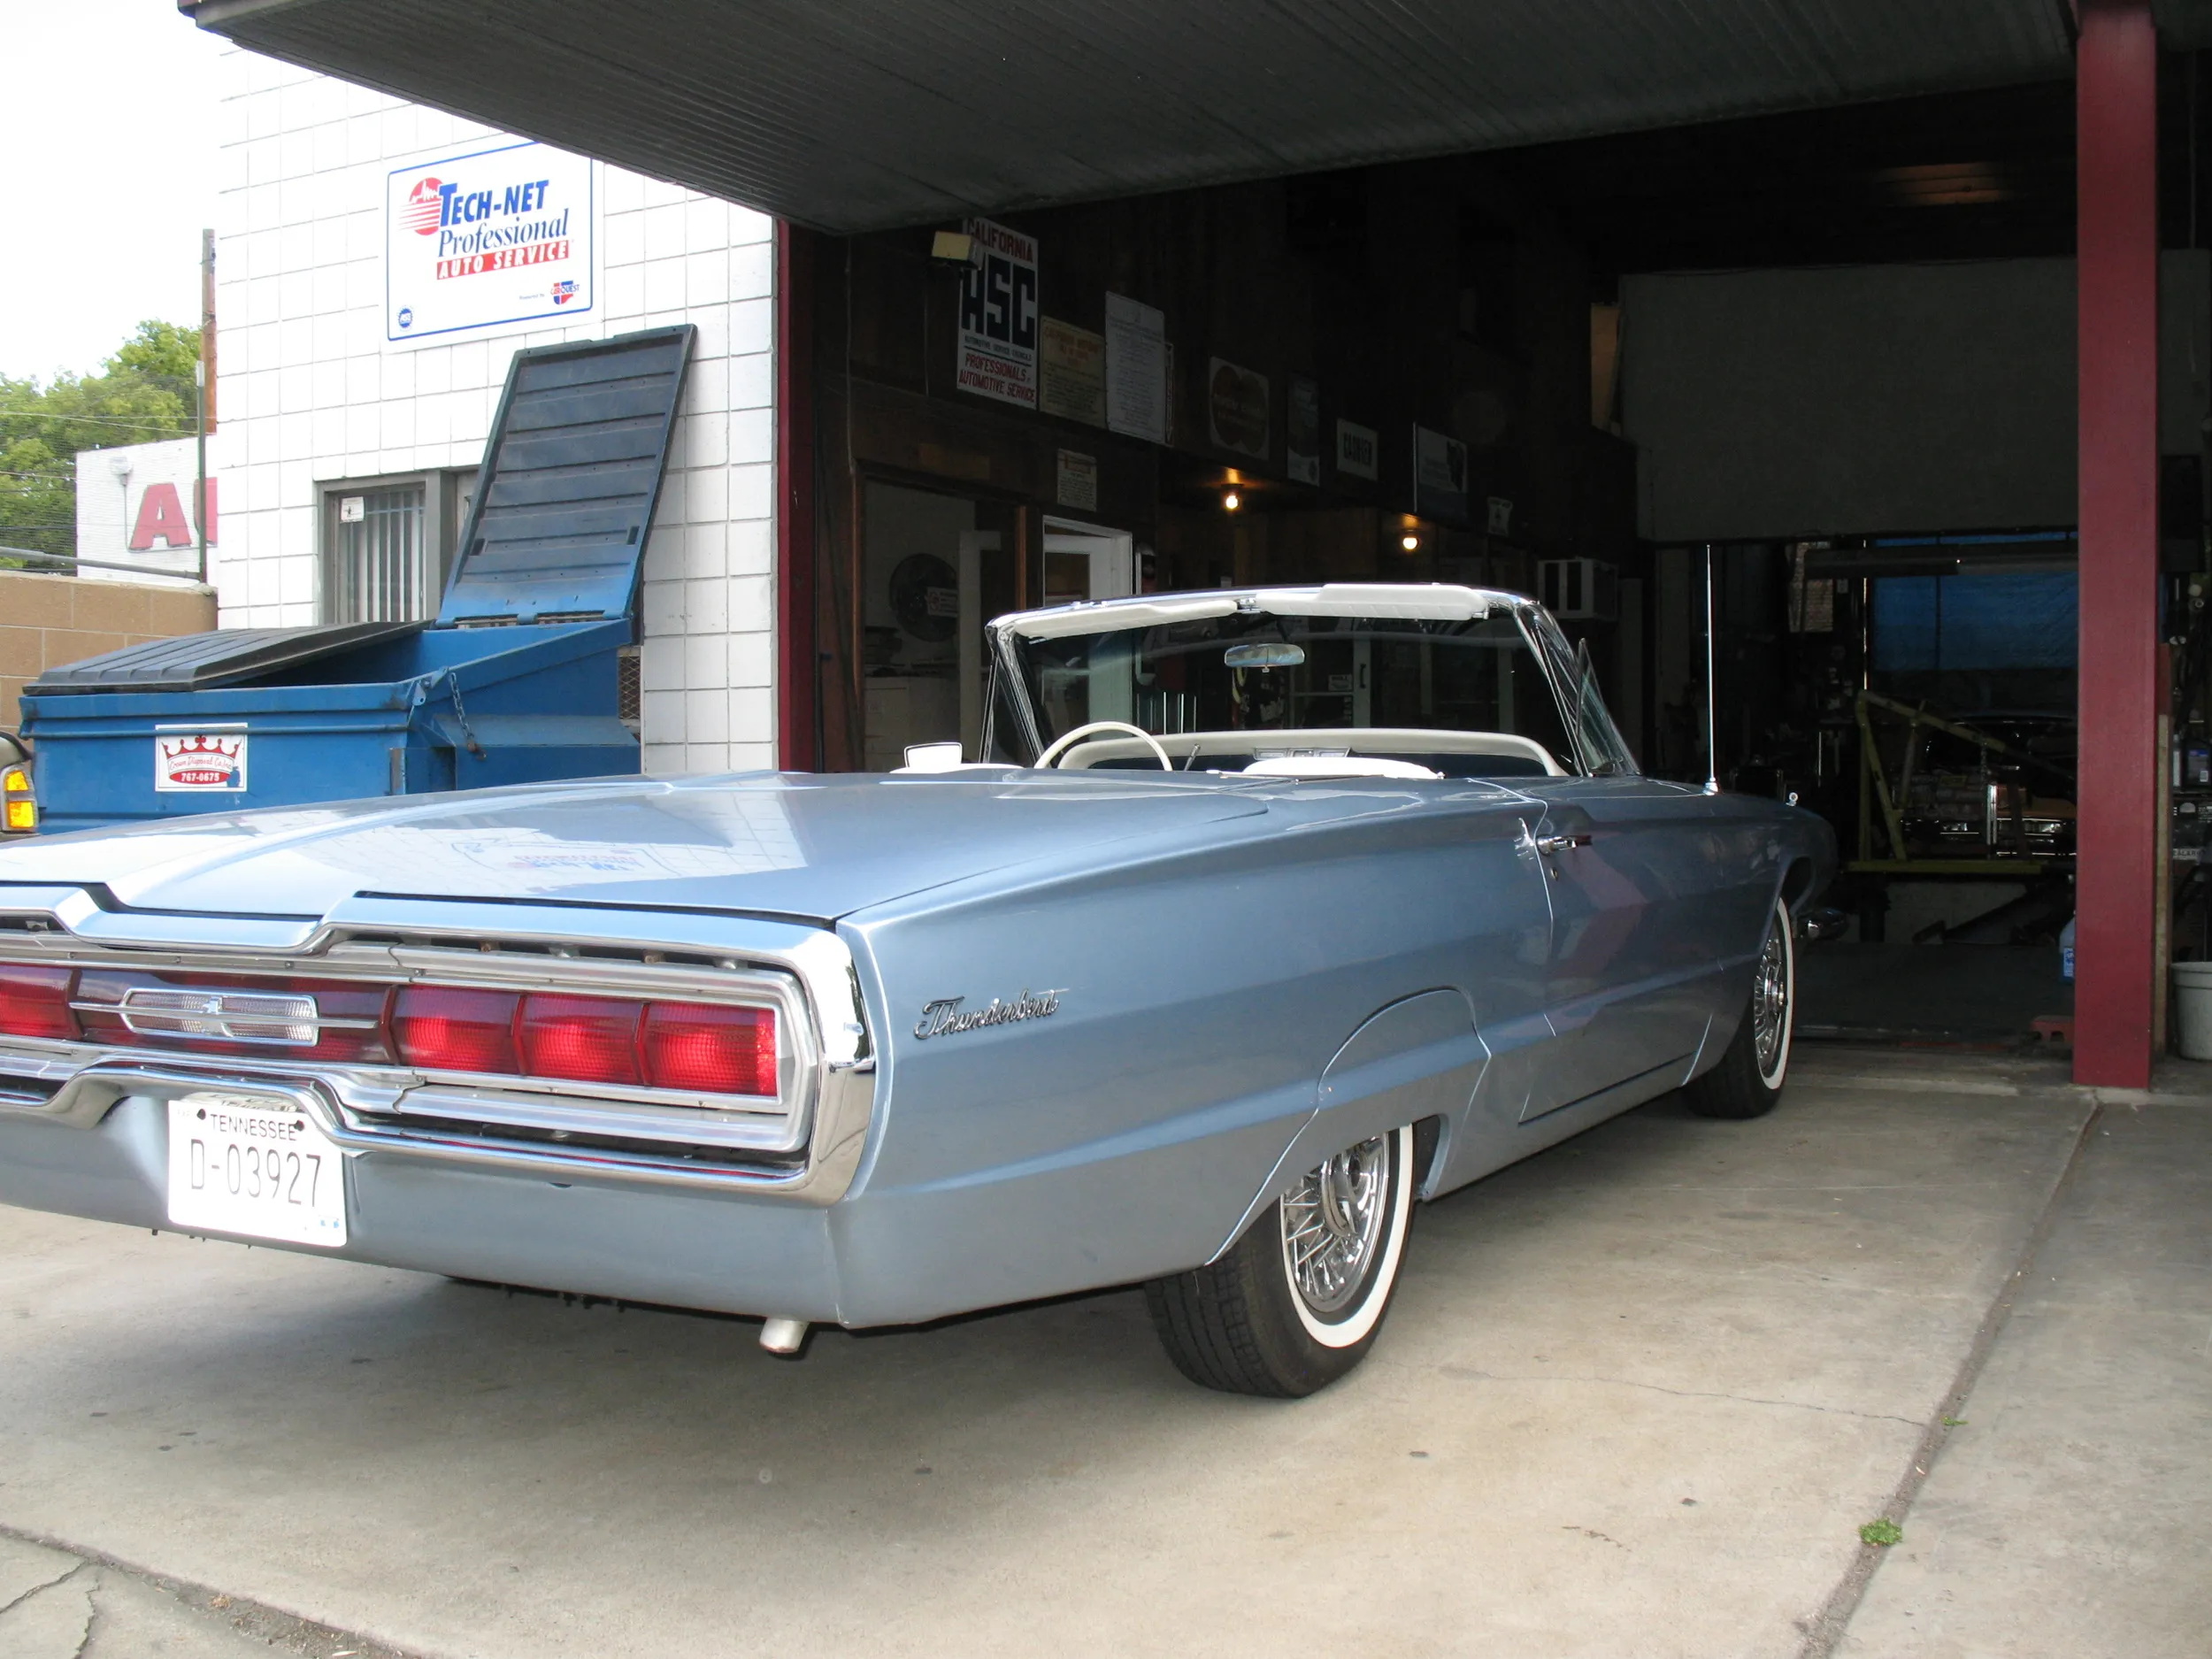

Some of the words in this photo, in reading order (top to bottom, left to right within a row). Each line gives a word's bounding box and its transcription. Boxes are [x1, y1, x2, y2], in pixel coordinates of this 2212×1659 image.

[439, 180, 549, 227] TECH-NET
[438, 208, 569, 257] Professional
[438, 255, 485, 280] AUTO
[493, 241, 568, 270] SERVICE
[958, 369, 1005, 395] AUTOMOTIVE
[1007, 381, 1036, 403] SERVICE
[965, 352, 1027, 382] PROFESSIONALS
[180, 772, 220, 782] 767-0675
[913, 987, 1070, 1041] Thunderbird
[210, 1113, 298, 1141] TENNESSEE
[190, 1139, 321, 1208] D-03927
